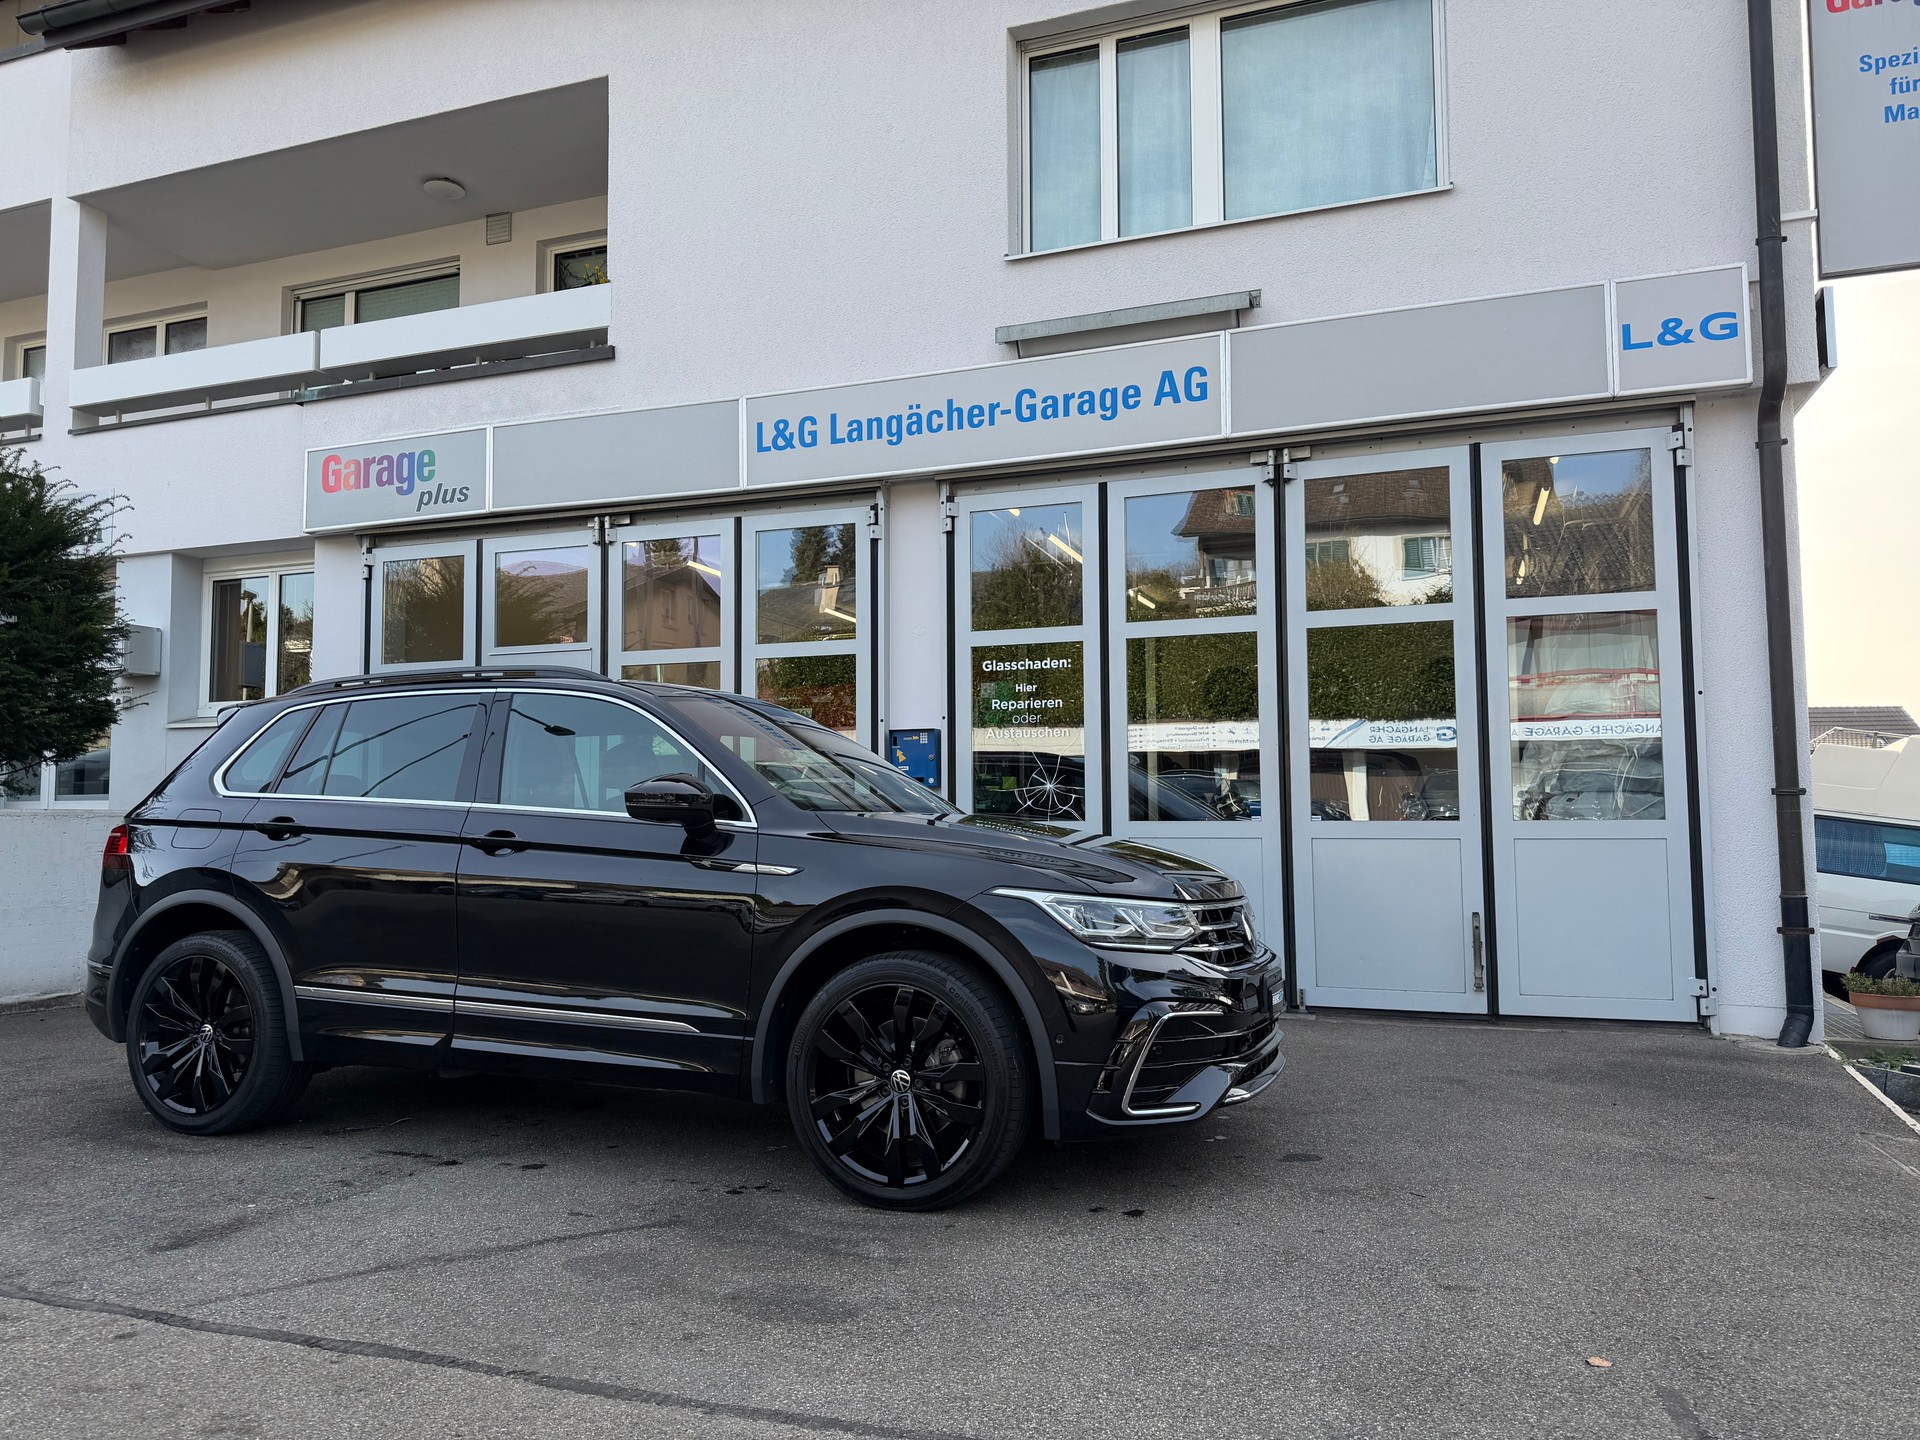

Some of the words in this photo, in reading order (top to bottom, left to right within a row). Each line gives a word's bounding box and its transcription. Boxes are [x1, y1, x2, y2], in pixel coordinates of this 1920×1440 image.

[1859, 47, 1918, 75] Spezi
[1622, 311, 1739, 351] L&G
[756, 415, 817, 453] L&G
[830, 382, 1141, 446] Langächer-Garage
[1154, 366, 1208, 406] AG
[321, 449, 436, 496] Garage
[415, 482, 470, 512] plus
[982, 657, 1072, 672] Glasschaden:
[1015, 683, 1037, 693] Hier
[991, 698, 1063, 711] Reparieren
[1012, 712, 1042, 724] oder
[986, 726, 1069, 739] Austauschen
